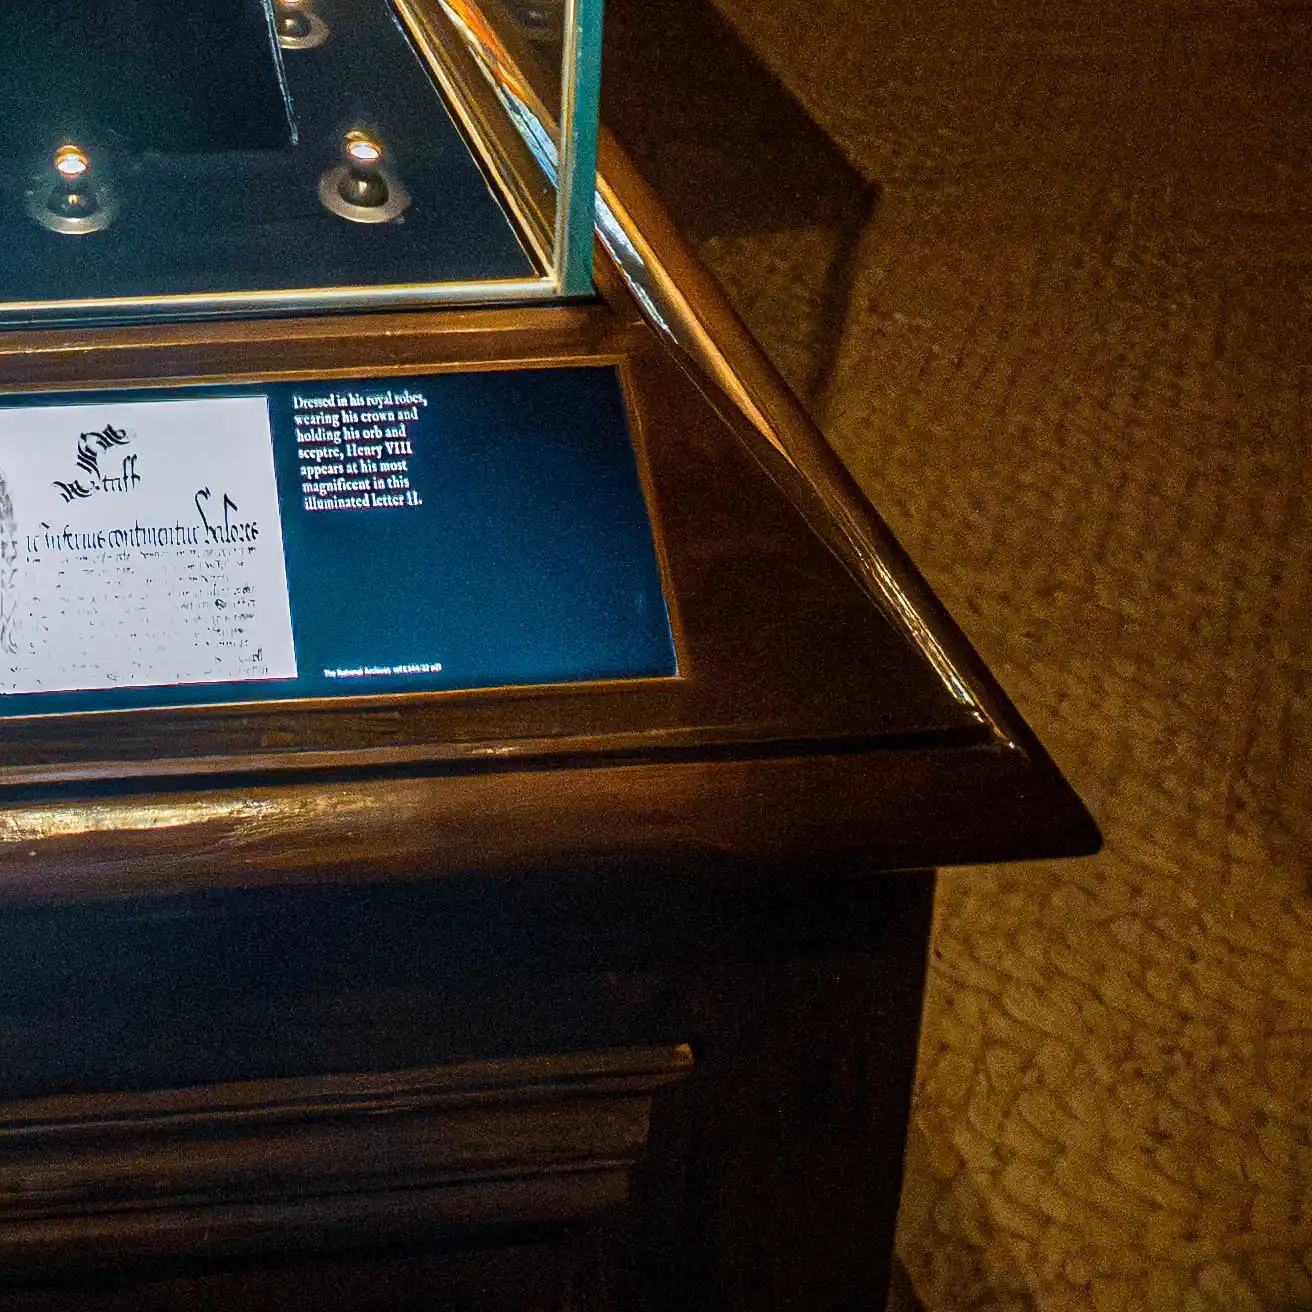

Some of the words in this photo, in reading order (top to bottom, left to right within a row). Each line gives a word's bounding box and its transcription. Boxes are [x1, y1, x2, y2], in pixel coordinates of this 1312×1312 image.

[293, 393, 336, 409] Dressed
[336, 394, 349, 407] in
[348, 393, 365, 407] his
[366, 391, 394, 409] royal
[394, 390, 428, 407] robes,
[294, 411, 340, 428] wearing
[340, 409, 359, 424] his
[360, 412, 396, 423] crown
[397, 406, 419, 421] and
[296, 427, 342, 445] holding
[342, 426, 361, 441] his
[362, 424, 383, 439] orb
[385, 422, 407, 438] and
[298, 446, 345, 463] sceptre,
[346, 443, 383, 459] Henry
[384, 441, 413, 455] VIII
[300, 464, 344, 480] appears
[346, 463, 359, 474] at
[359, 459, 378, 473] his
[379, 460, 408, 472] most
[302, 477, 371, 497] magnificent
[373, 476, 386, 490] in
[386, 475, 410, 489] this
